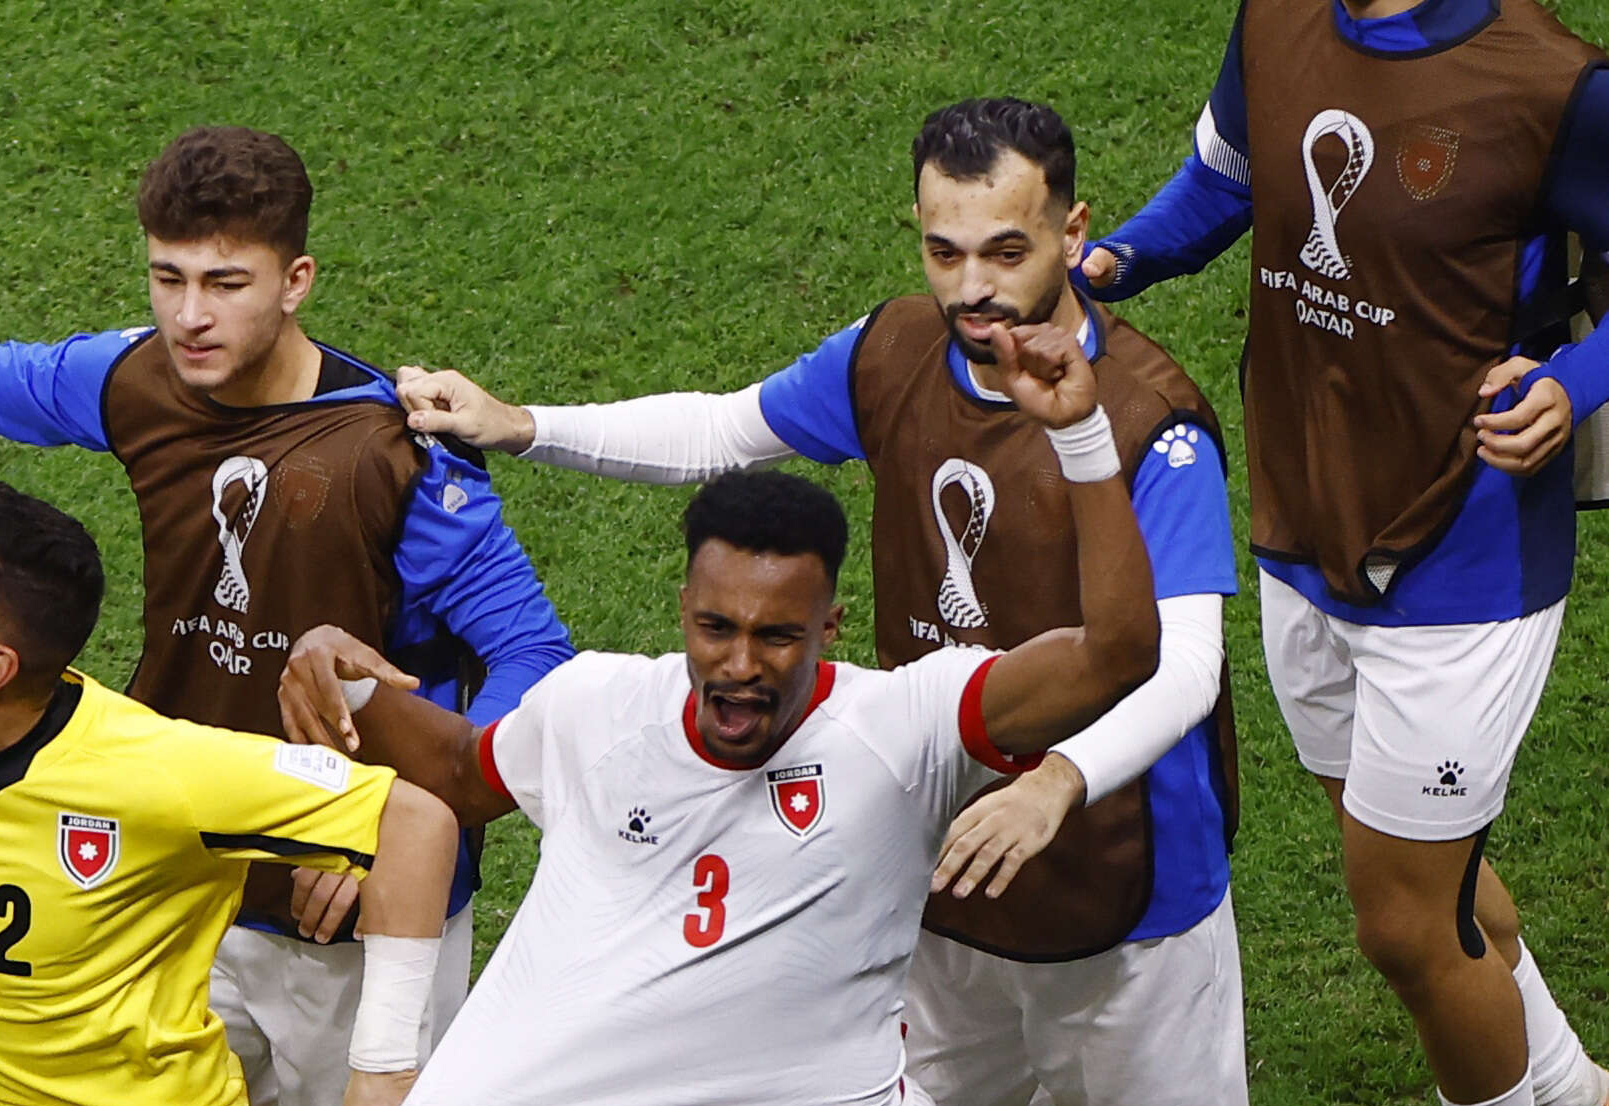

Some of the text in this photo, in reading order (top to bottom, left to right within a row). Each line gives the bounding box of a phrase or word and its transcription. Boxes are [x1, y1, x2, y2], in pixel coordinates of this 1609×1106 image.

[1260, 267, 1395, 326] FIFA ARAB CUP
[1295, 299, 1354, 340] QATAR
[774, 766, 817, 780] JORDAN
[1422, 786, 1467, 797] KELME
[68, 816, 110, 829] JORDAN
[618, 830, 659, 845] KELME
[683, 854, 730, 948] 3
